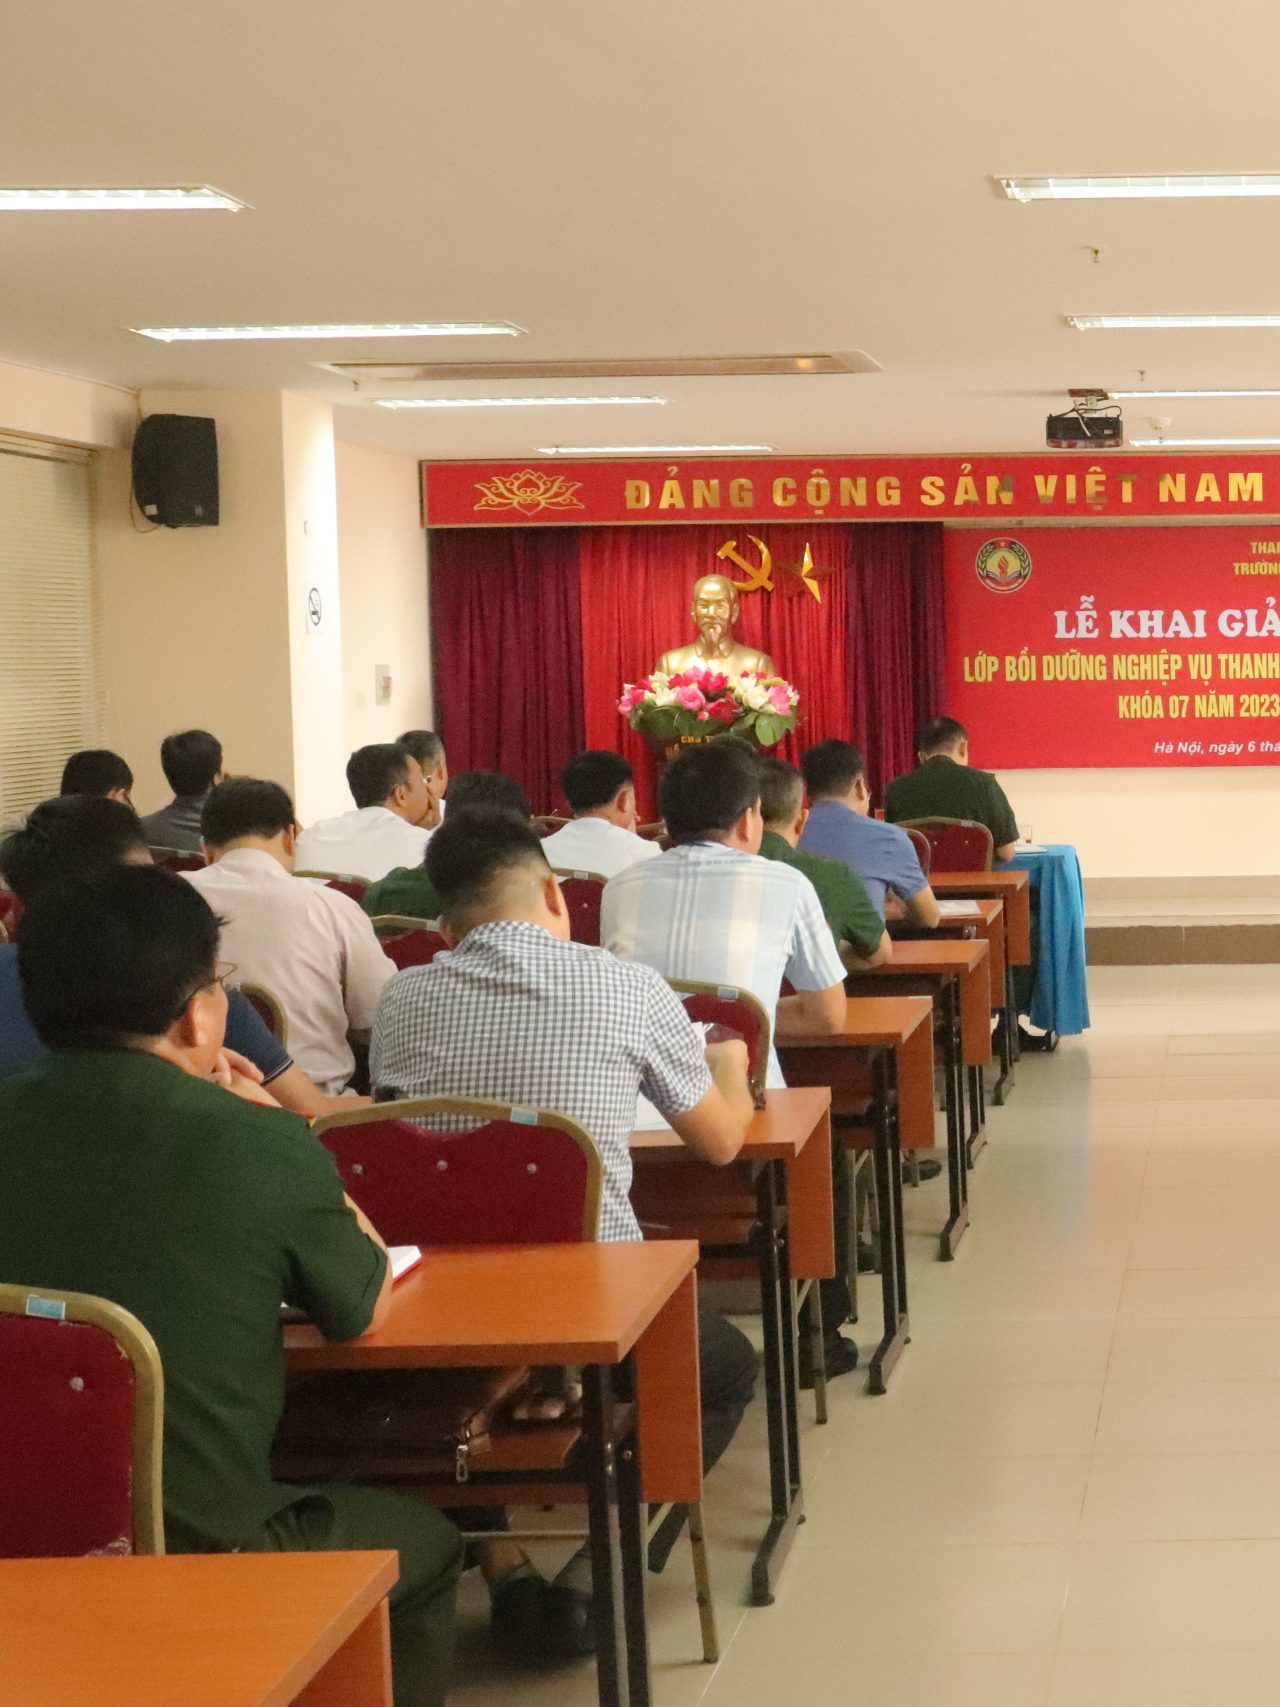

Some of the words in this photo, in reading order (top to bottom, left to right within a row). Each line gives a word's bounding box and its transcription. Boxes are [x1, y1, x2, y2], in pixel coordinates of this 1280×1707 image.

[625, 466, 753, 509] ĐẢNG
[773, 469, 901, 515] CỘNG
[921, 463, 1013, 506] SẢN
[1034, 466, 1138, 511] VIỆT
[1159, 473, 1263, 502] NAM
[1054, 595, 1099, 638] LỄ
[1109, 610, 1207, 638] KHAI
[964, 651, 999, 682] LỚP
[1113, 649, 1182, 685] NGHIỆP
[1188, 654, 1212, 685] VỤ
[1218, 653, 1280, 679] THANH
[1119, 690, 1164, 718] KHÓA
[1169, 695, 1189, 718] 07
[1195, 690, 1234, 717] NĂM
[1240, 694, 1280, 717] 2023
[1248, 741, 1255, 752] 6
